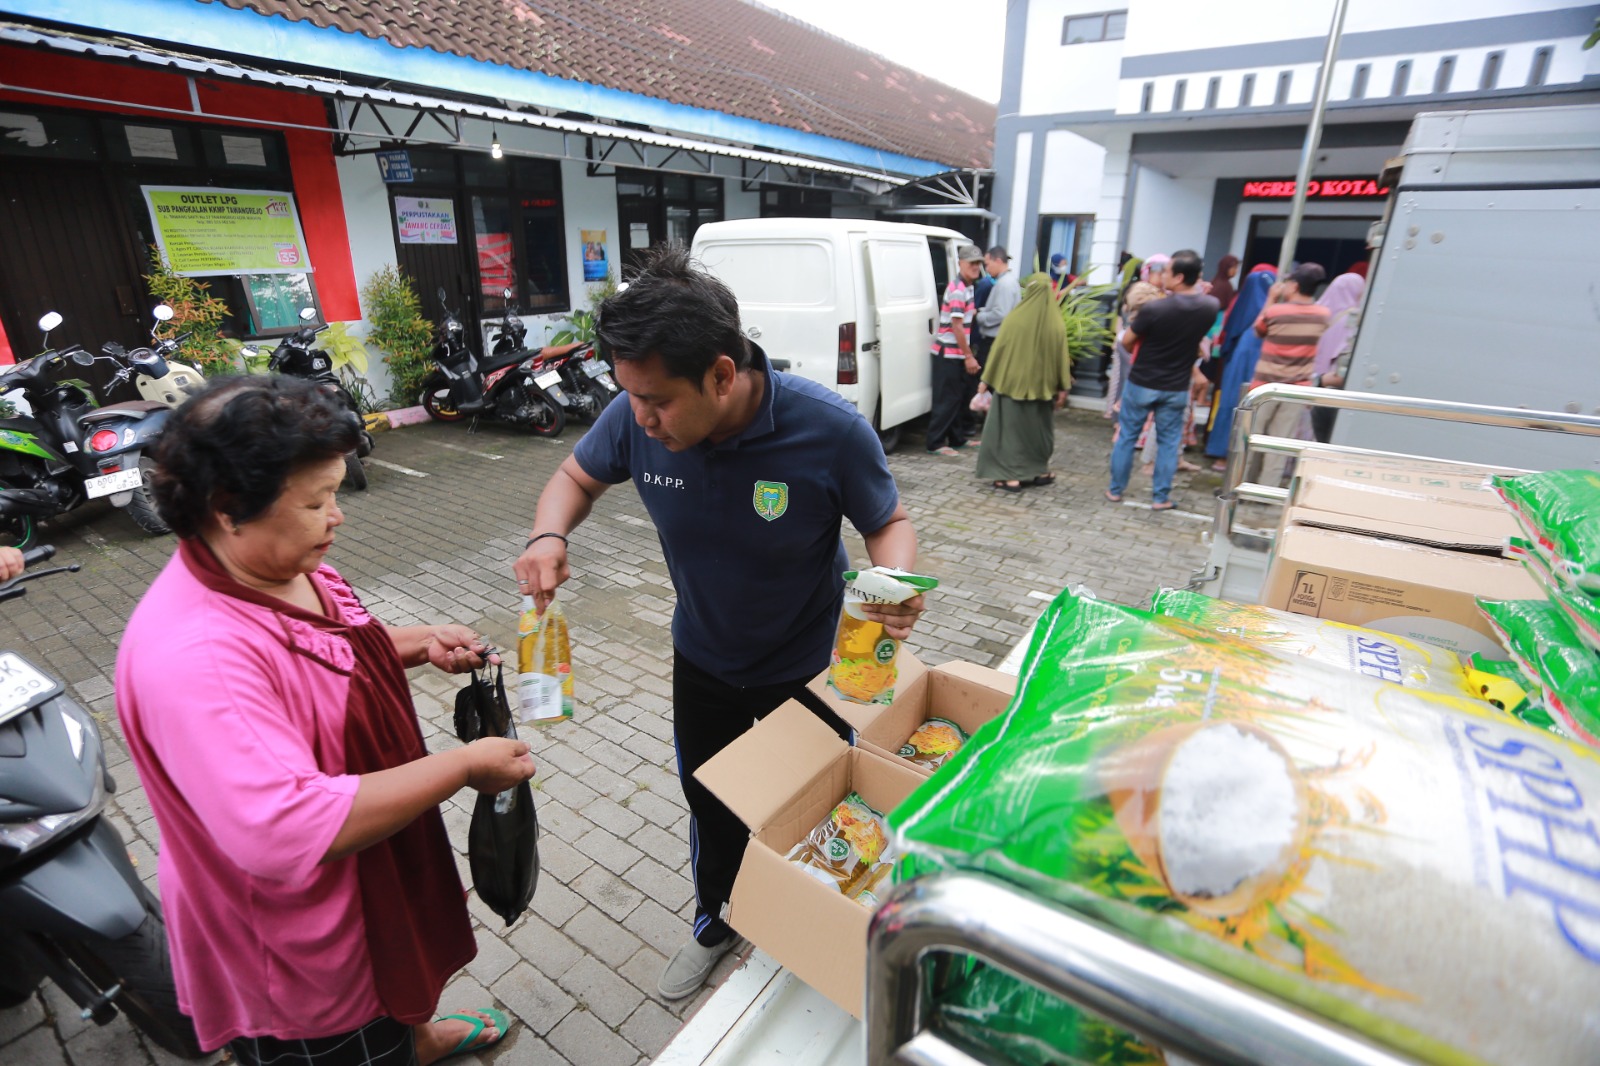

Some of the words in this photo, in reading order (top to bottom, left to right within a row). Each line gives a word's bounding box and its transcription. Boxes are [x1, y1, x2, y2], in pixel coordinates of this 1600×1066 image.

[379, 156, 389, 179] P
[1243, 181, 1320, 197] NGREO
[1320, 180, 1378, 196] KOTA
[180, 194, 217, 204] OUTLET
[219, 195, 238, 205] LPG
[157, 205, 171, 213] SUB
[171, 205, 208, 213] PANGKALAN
[226, 206, 263, 215] TAWANGREJO
[276, 251, 298, 263] 135
[643, 472, 686, 490] D.K.P.P.
[1302, 582, 1314, 595] 1L
[1357, 636, 1403, 686] SPH
[1160, 667, 1203, 684] 5
[1145, 684, 1185, 708] kg
